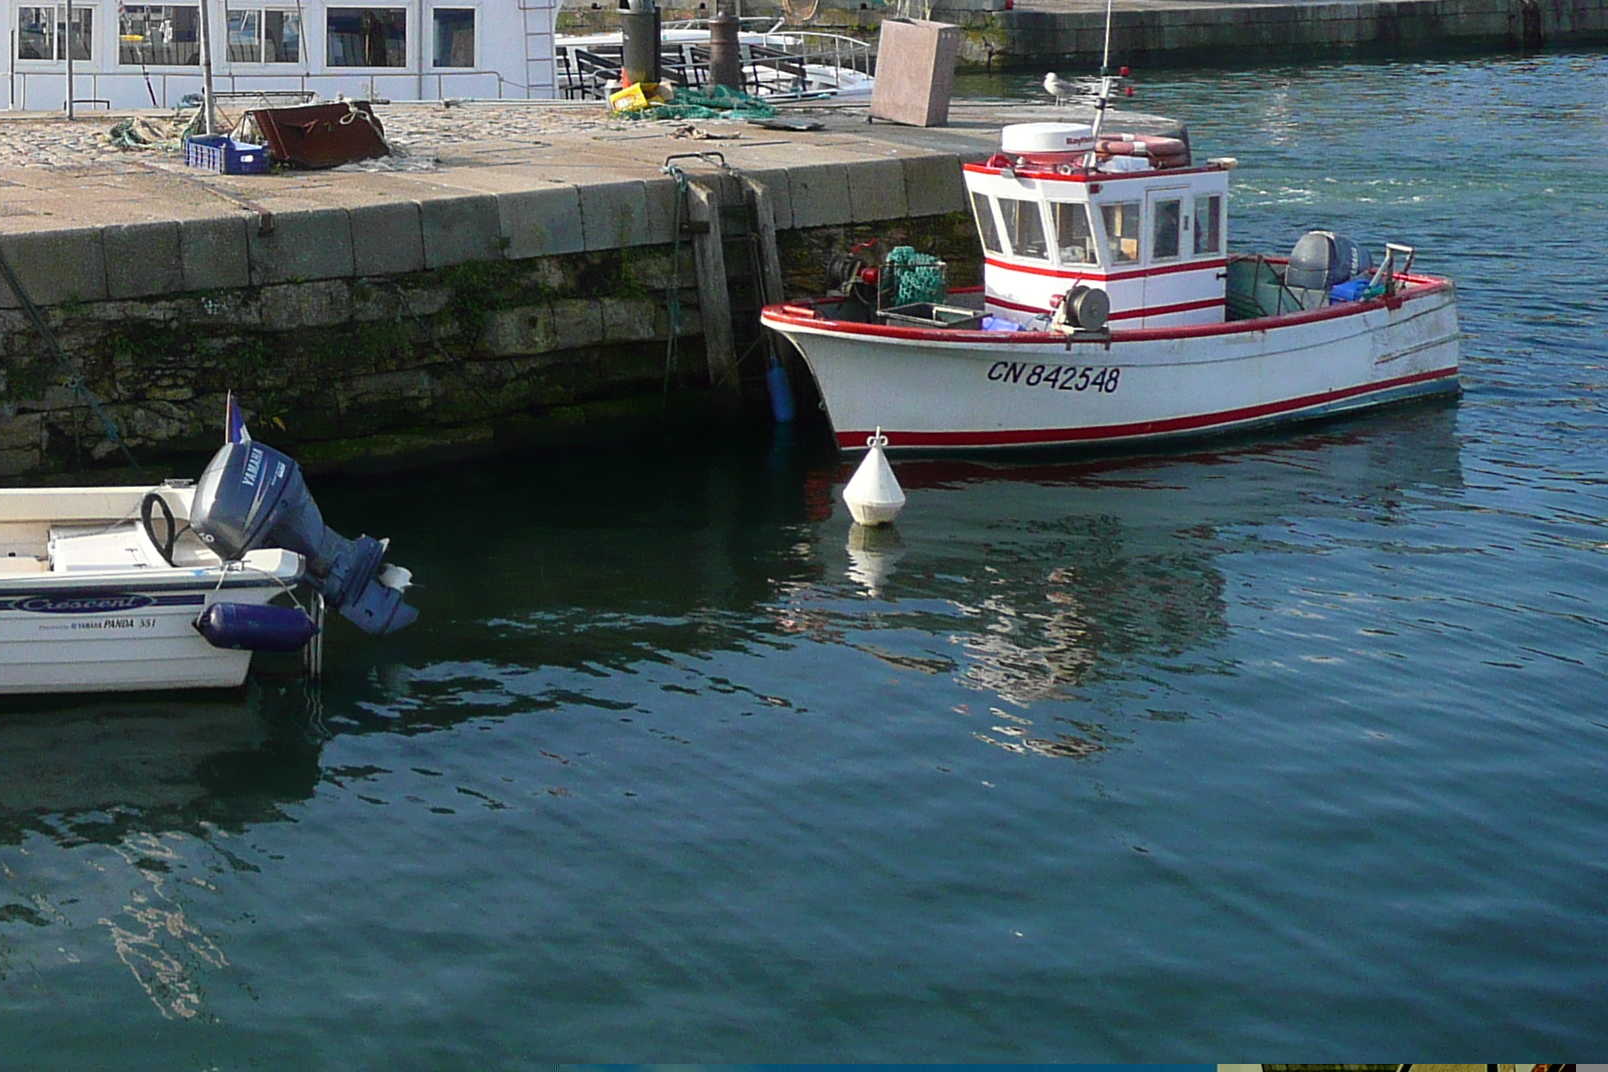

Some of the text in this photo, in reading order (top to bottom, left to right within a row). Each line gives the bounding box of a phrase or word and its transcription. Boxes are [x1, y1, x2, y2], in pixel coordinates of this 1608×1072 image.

[987, 361, 1121, 394] CN 842548
[242, 447, 265, 487] YAMAHA
[23, 595, 139, 611] Crescent
[103, 618, 134, 629] PANDA
[139, 618, 156, 628] 551
